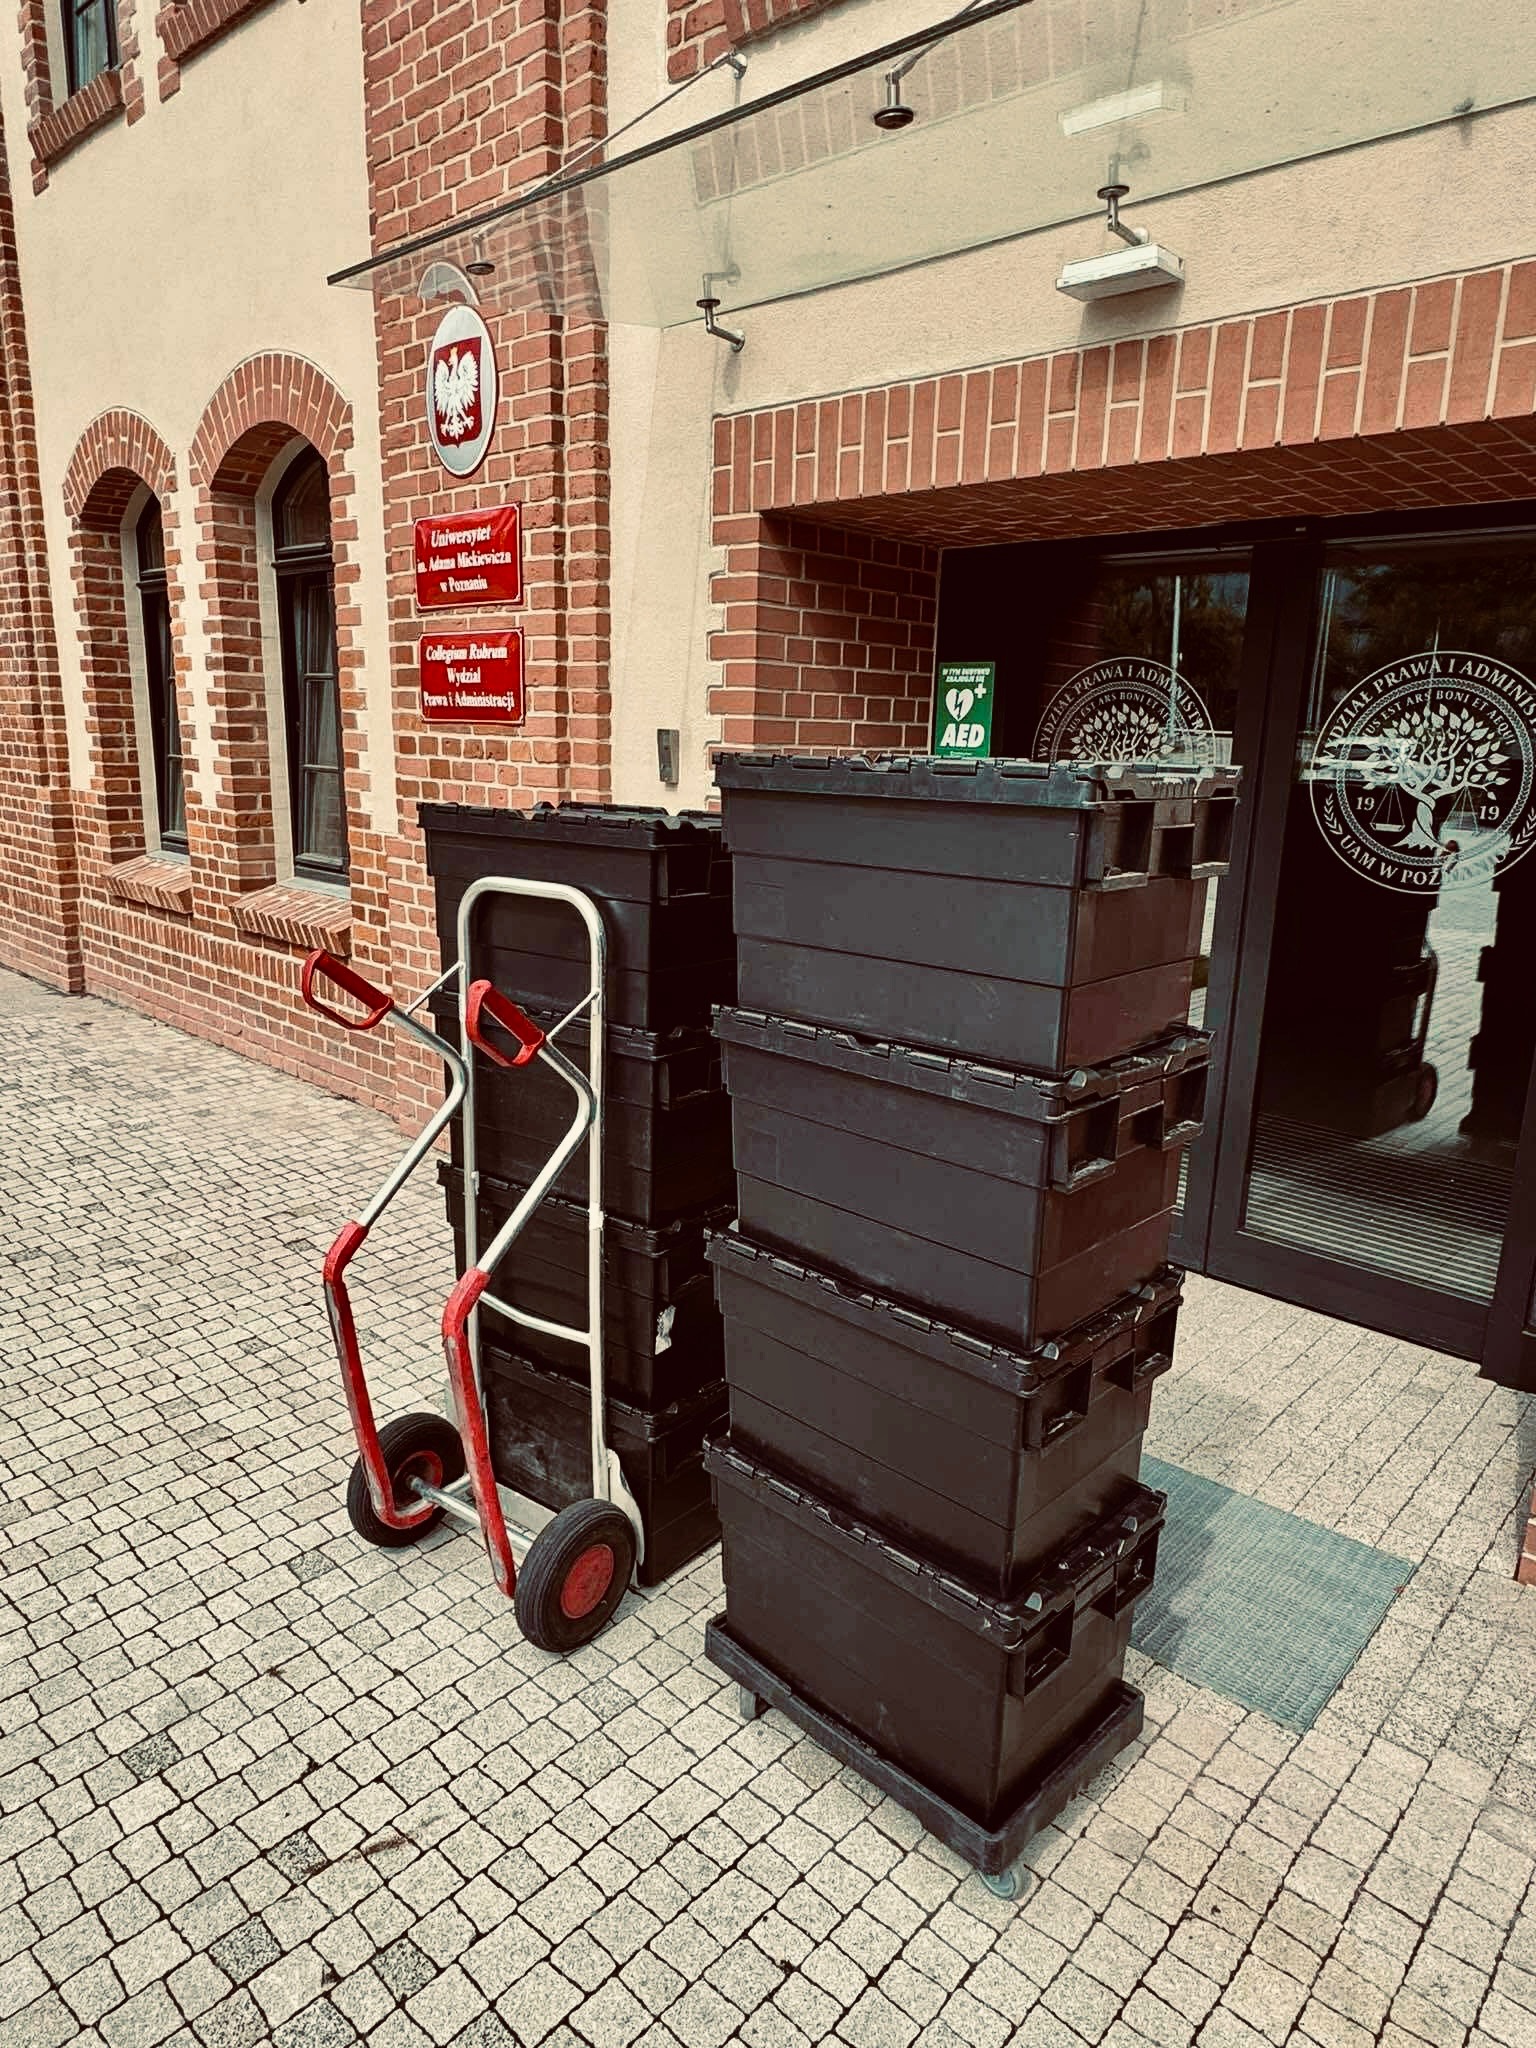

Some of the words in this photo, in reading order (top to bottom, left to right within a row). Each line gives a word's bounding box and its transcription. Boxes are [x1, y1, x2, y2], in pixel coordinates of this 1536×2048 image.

[431, 525, 492, 548] Uniwersytet
[429, 556, 455, 573] Adama
[457, 550, 512, 569] Mickiewicza
[440, 582, 448, 593] w
[448, 575, 488, 593] Poznaniu
[426, 644, 467, 665] Collegium
[469, 642, 508, 660] Rubrum
[446, 666, 481, 687] Wydział
[1373, 656, 1442, 694] PRAWA
[1447, 658, 1456, 674] I
[423, 691, 448, 708] Prawa
[455, 690, 514, 713] Administracji
[1098, 693, 1116, 706] ARS
[1120, 692, 1145, 704] BONI
[1038, 692, 1075, 758] WYDZIAŁ
[1073, 665, 1123, 695] PRAWA
[1127, 665, 1133, 677] I
[1381, 702, 1402, 720] EST
[1406, 691, 1430, 707] ARS
[1436, 689, 1471, 704] BONI
[1472, 698, 1489, 712] ET
[1487, 709, 1516, 745] AEQUI
[940, 723, 985, 748] AED
[1356, 796, 1375, 812] 19
[1479, 805, 1500, 821] 19
[1340, 834, 1377, 870] UAM
[1379, 862, 1398, 880] W
